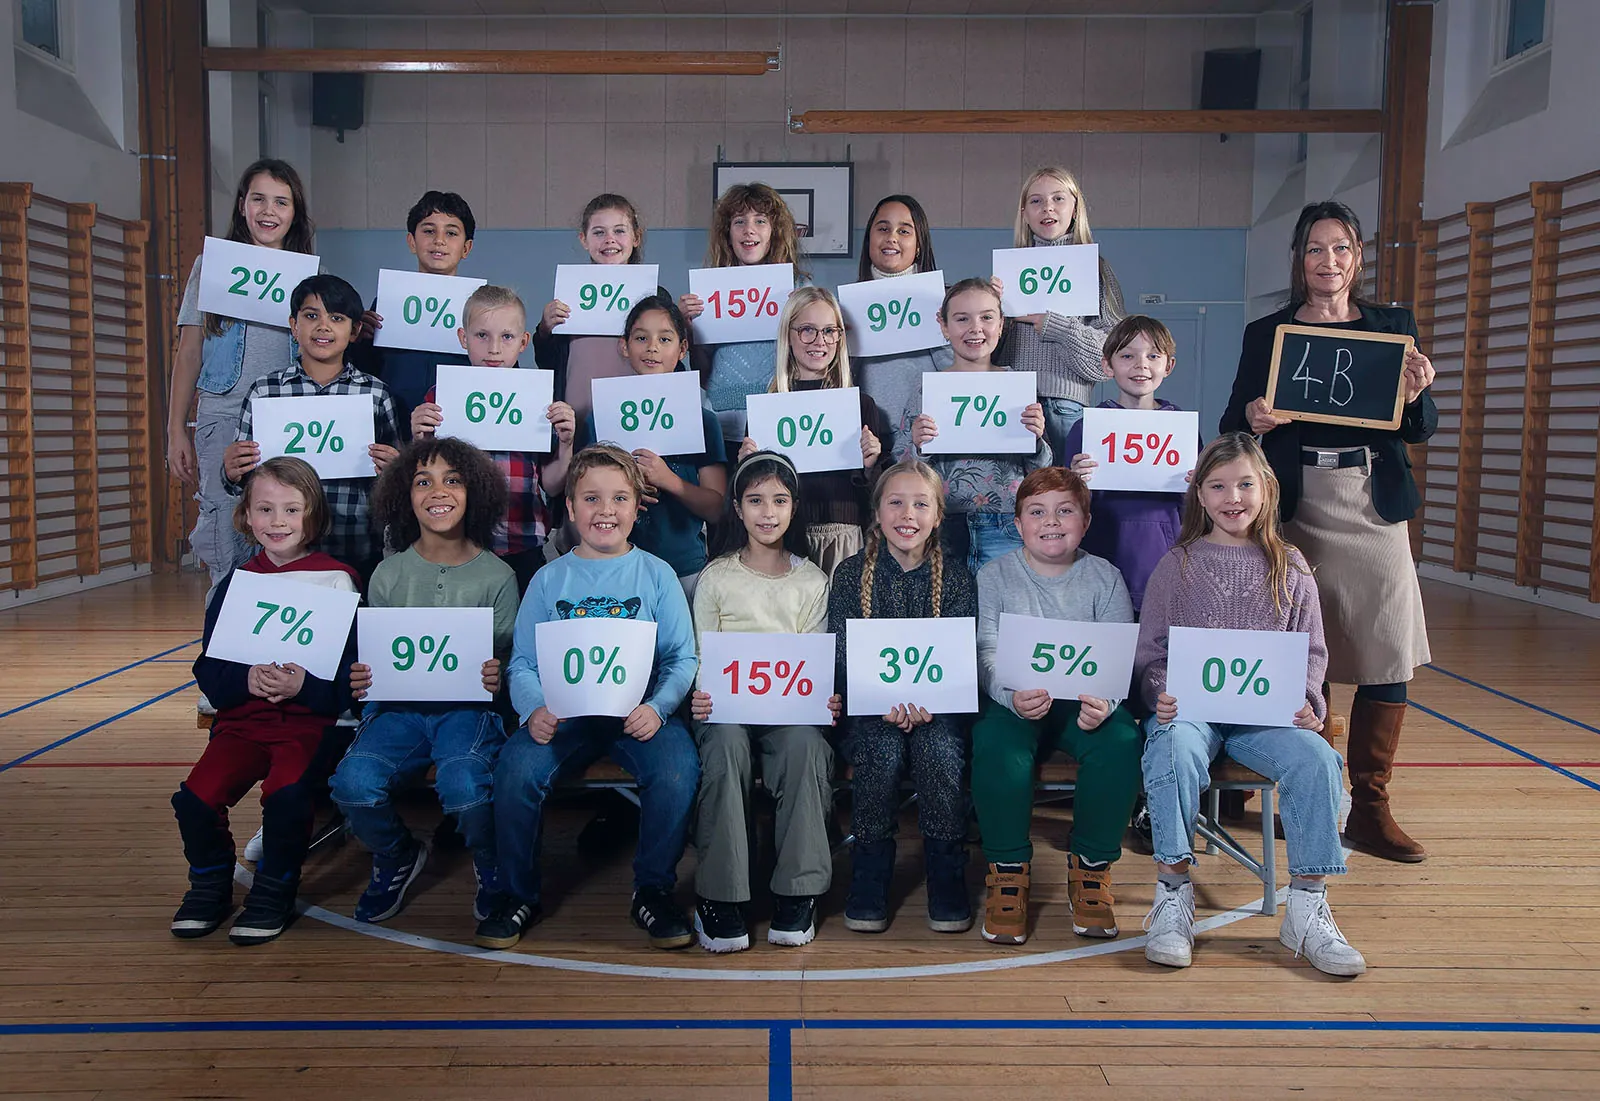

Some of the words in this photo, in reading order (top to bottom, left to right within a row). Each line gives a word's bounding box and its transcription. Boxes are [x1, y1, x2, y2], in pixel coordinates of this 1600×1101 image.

[229, 267, 285, 303] 2%
[579, 283, 630, 311] 9%
[1020, 266, 1072, 295] 6%
[403, 295, 455, 329] 0%
[707, 283, 778, 318] 15%
[868, 297, 921, 331] 9%
[465, 391, 523, 425] 6%
[620, 399, 674, 432] 8%
[951, 395, 1007, 427] 7%
[284, 420, 344, 454] 2%
[777, 413, 833, 448] 0%
[1102, 432, 1180, 466] 15%
[253, 601, 314, 646] 7%
[391, 635, 458, 672] 9%
[563, 646, 626, 684] 0%
[879, 646, 943, 684] 3%
[1031, 642, 1098, 677] 5%
[723, 660, 813, 697] 15%
[1202, 657, 1270, 696] 0%
